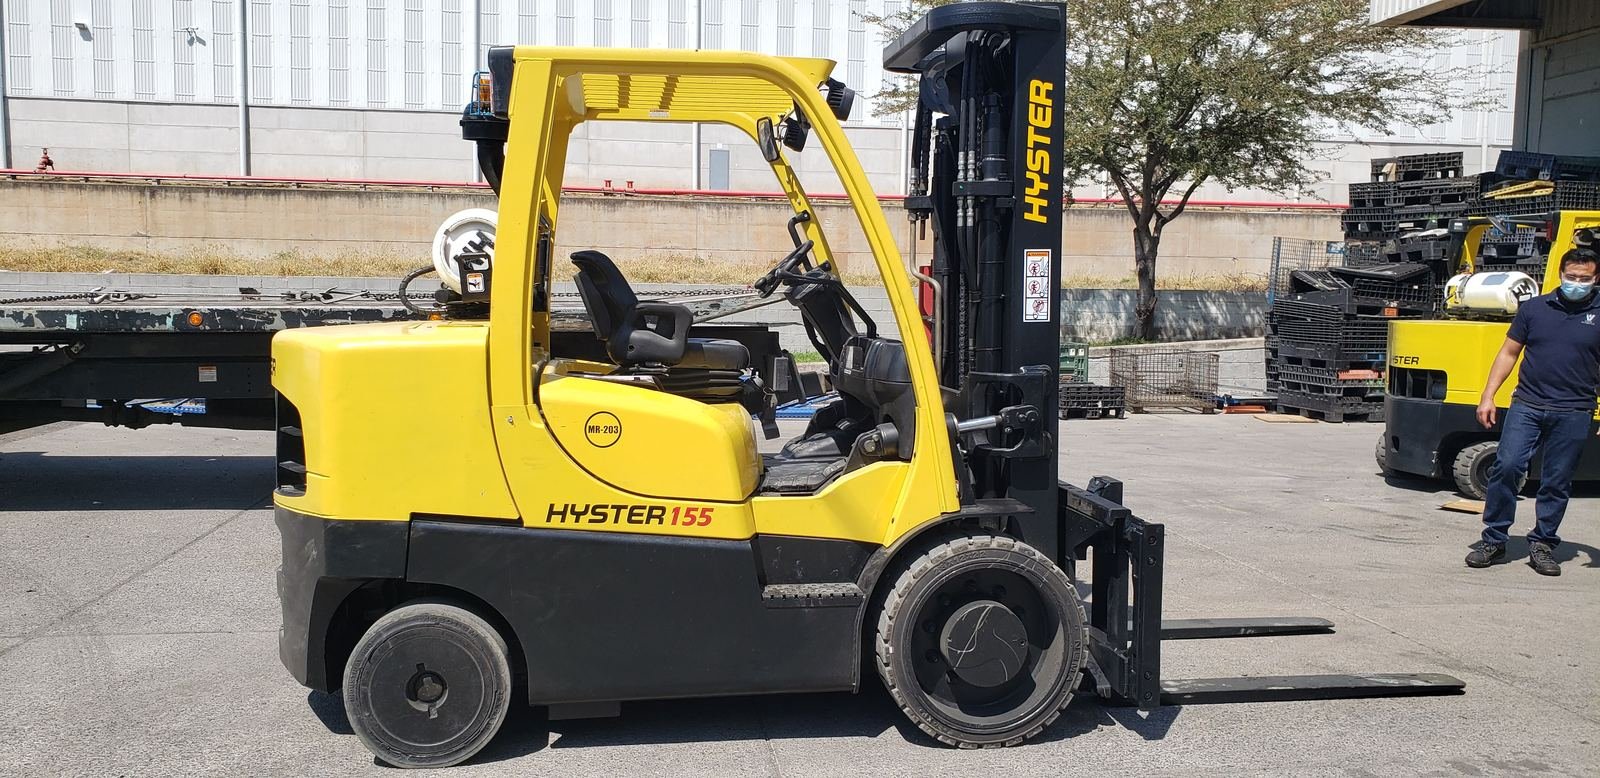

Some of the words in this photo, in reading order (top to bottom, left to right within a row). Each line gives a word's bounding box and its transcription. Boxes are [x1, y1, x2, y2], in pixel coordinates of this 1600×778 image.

[1023, 79, 1054, 223] HYSTER
[587, 424, 619, 435] MR-203
[545, 503, 667, 525] HYSTER
[670, 506, 714, 527] 155
